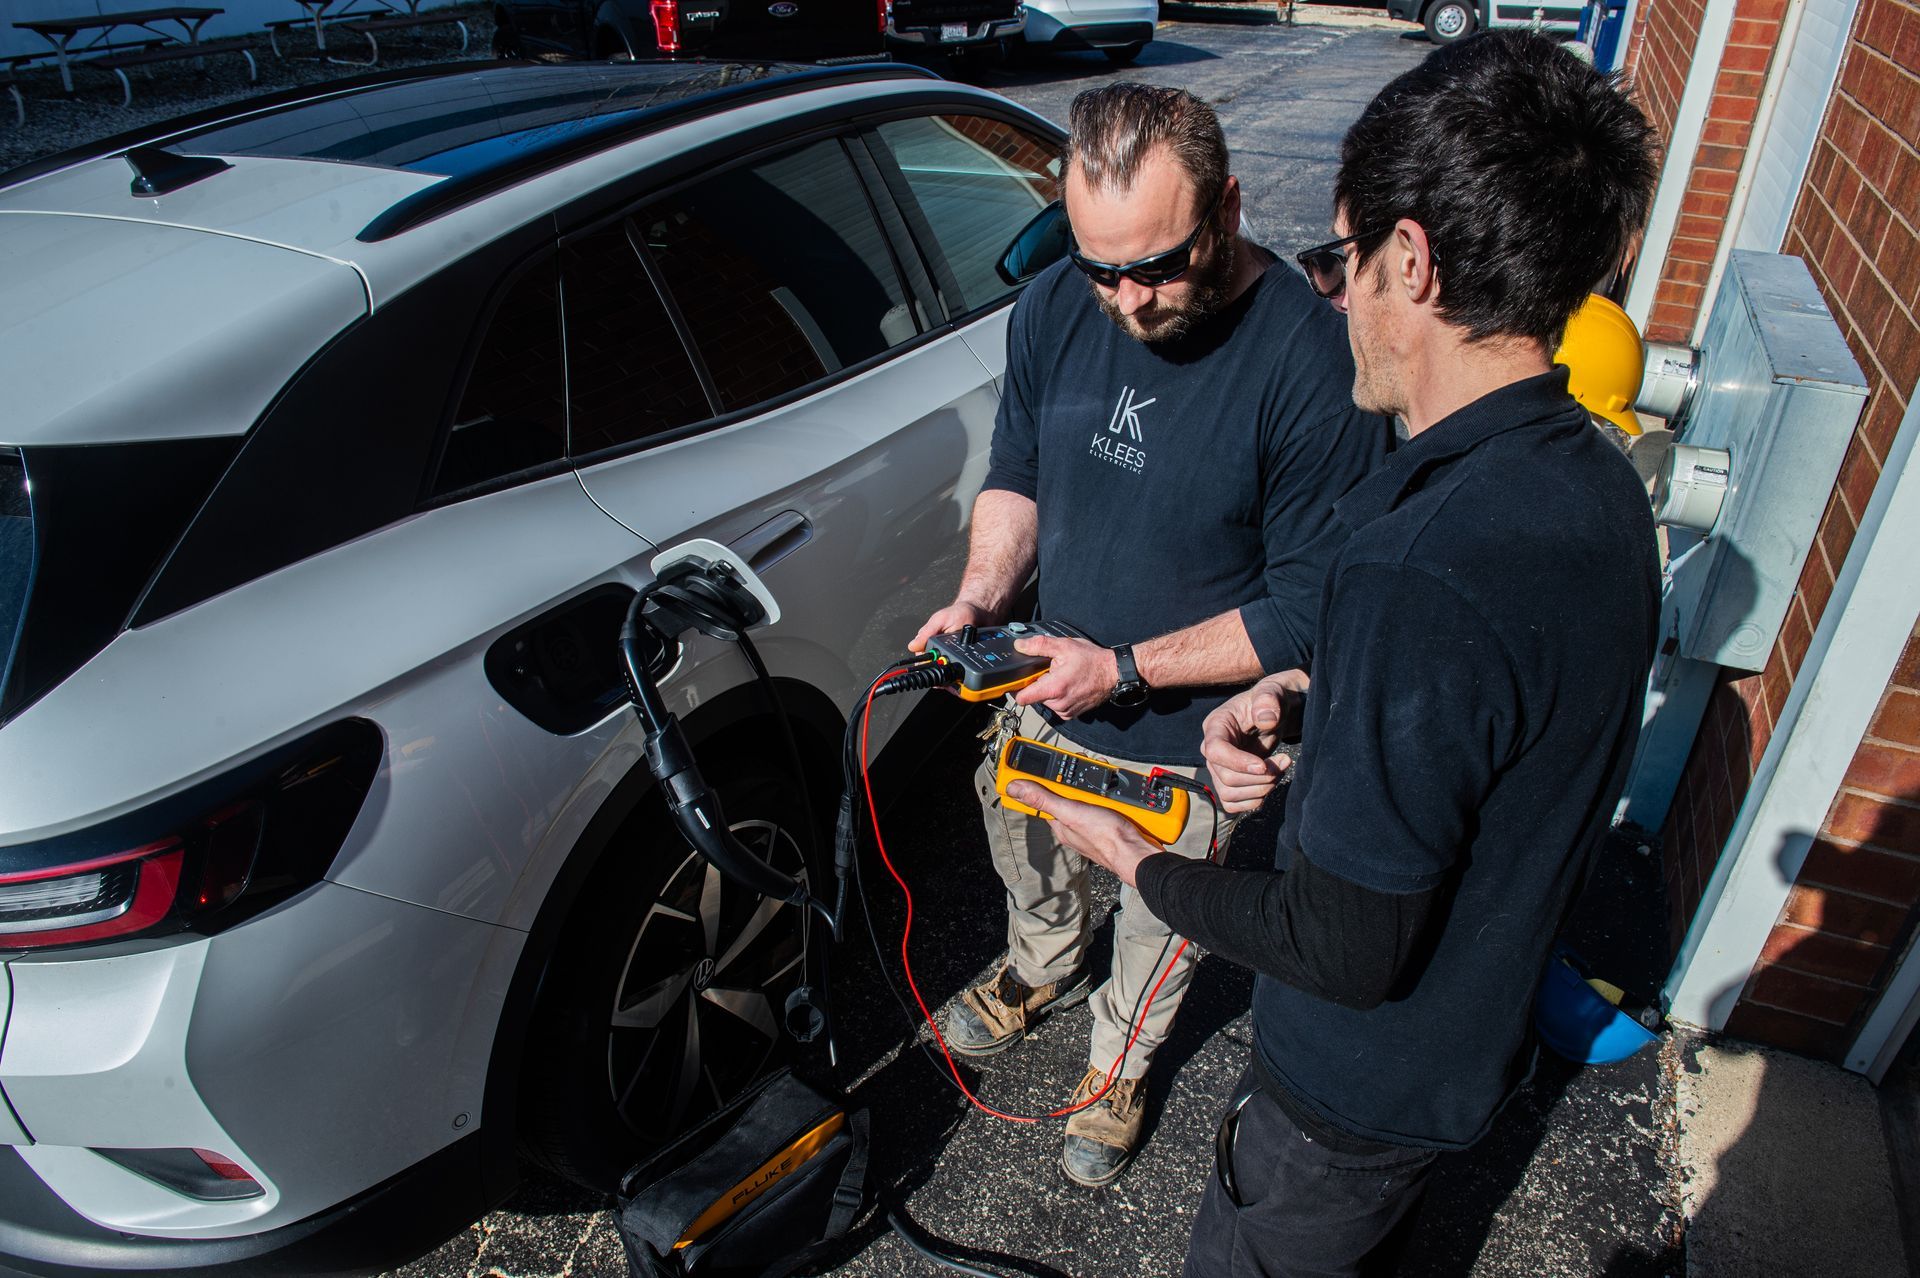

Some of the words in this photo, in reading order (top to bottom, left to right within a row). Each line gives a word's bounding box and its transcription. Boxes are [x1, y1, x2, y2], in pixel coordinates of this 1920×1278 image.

[1089, 449, 1127, 469] ELECTRIC
[1129, 466, 1142, 475] INC
[1091, 432, 1146, 468] KLEES
[732, 1156, 793, 1205] FLUKE
